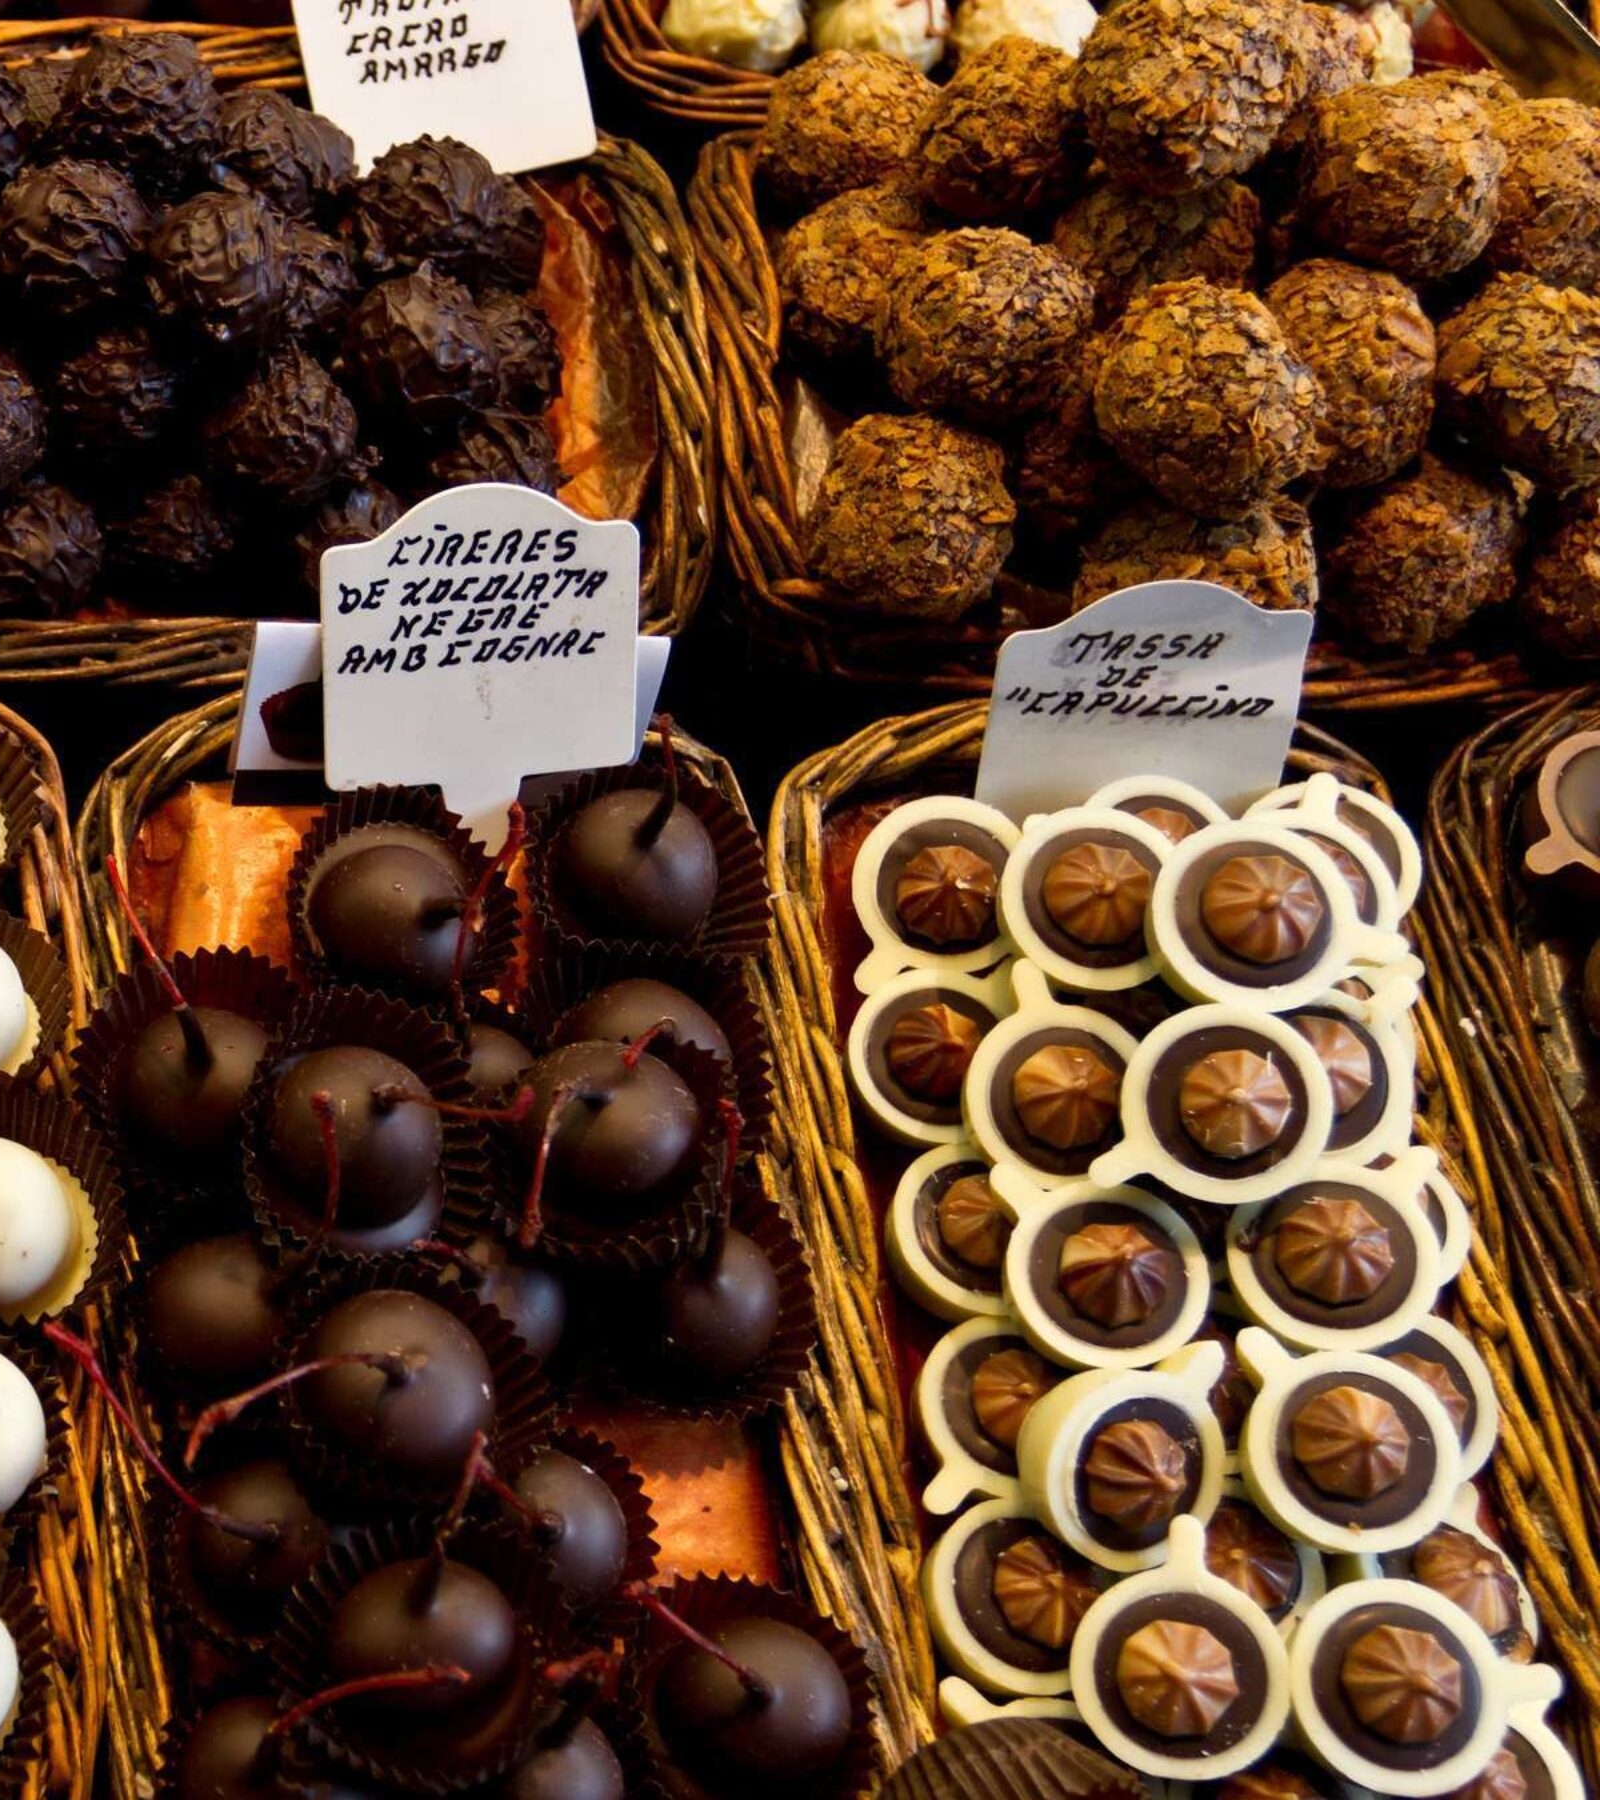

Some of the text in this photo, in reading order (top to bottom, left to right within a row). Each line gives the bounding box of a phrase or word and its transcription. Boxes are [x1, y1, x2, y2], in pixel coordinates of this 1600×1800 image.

[346, 14, 468, 56] CACAO
[359, 39, 506, 84] AMARGO
[338, 568, 608, 614] DE XOCOLATA
[390, 602, 550, 642] NEGRE
[337, 628, 606, 674] AMB COGNAC
[1068, 630, 1226, 664] TASSA
[1096, 664, 1158, 688] DE
